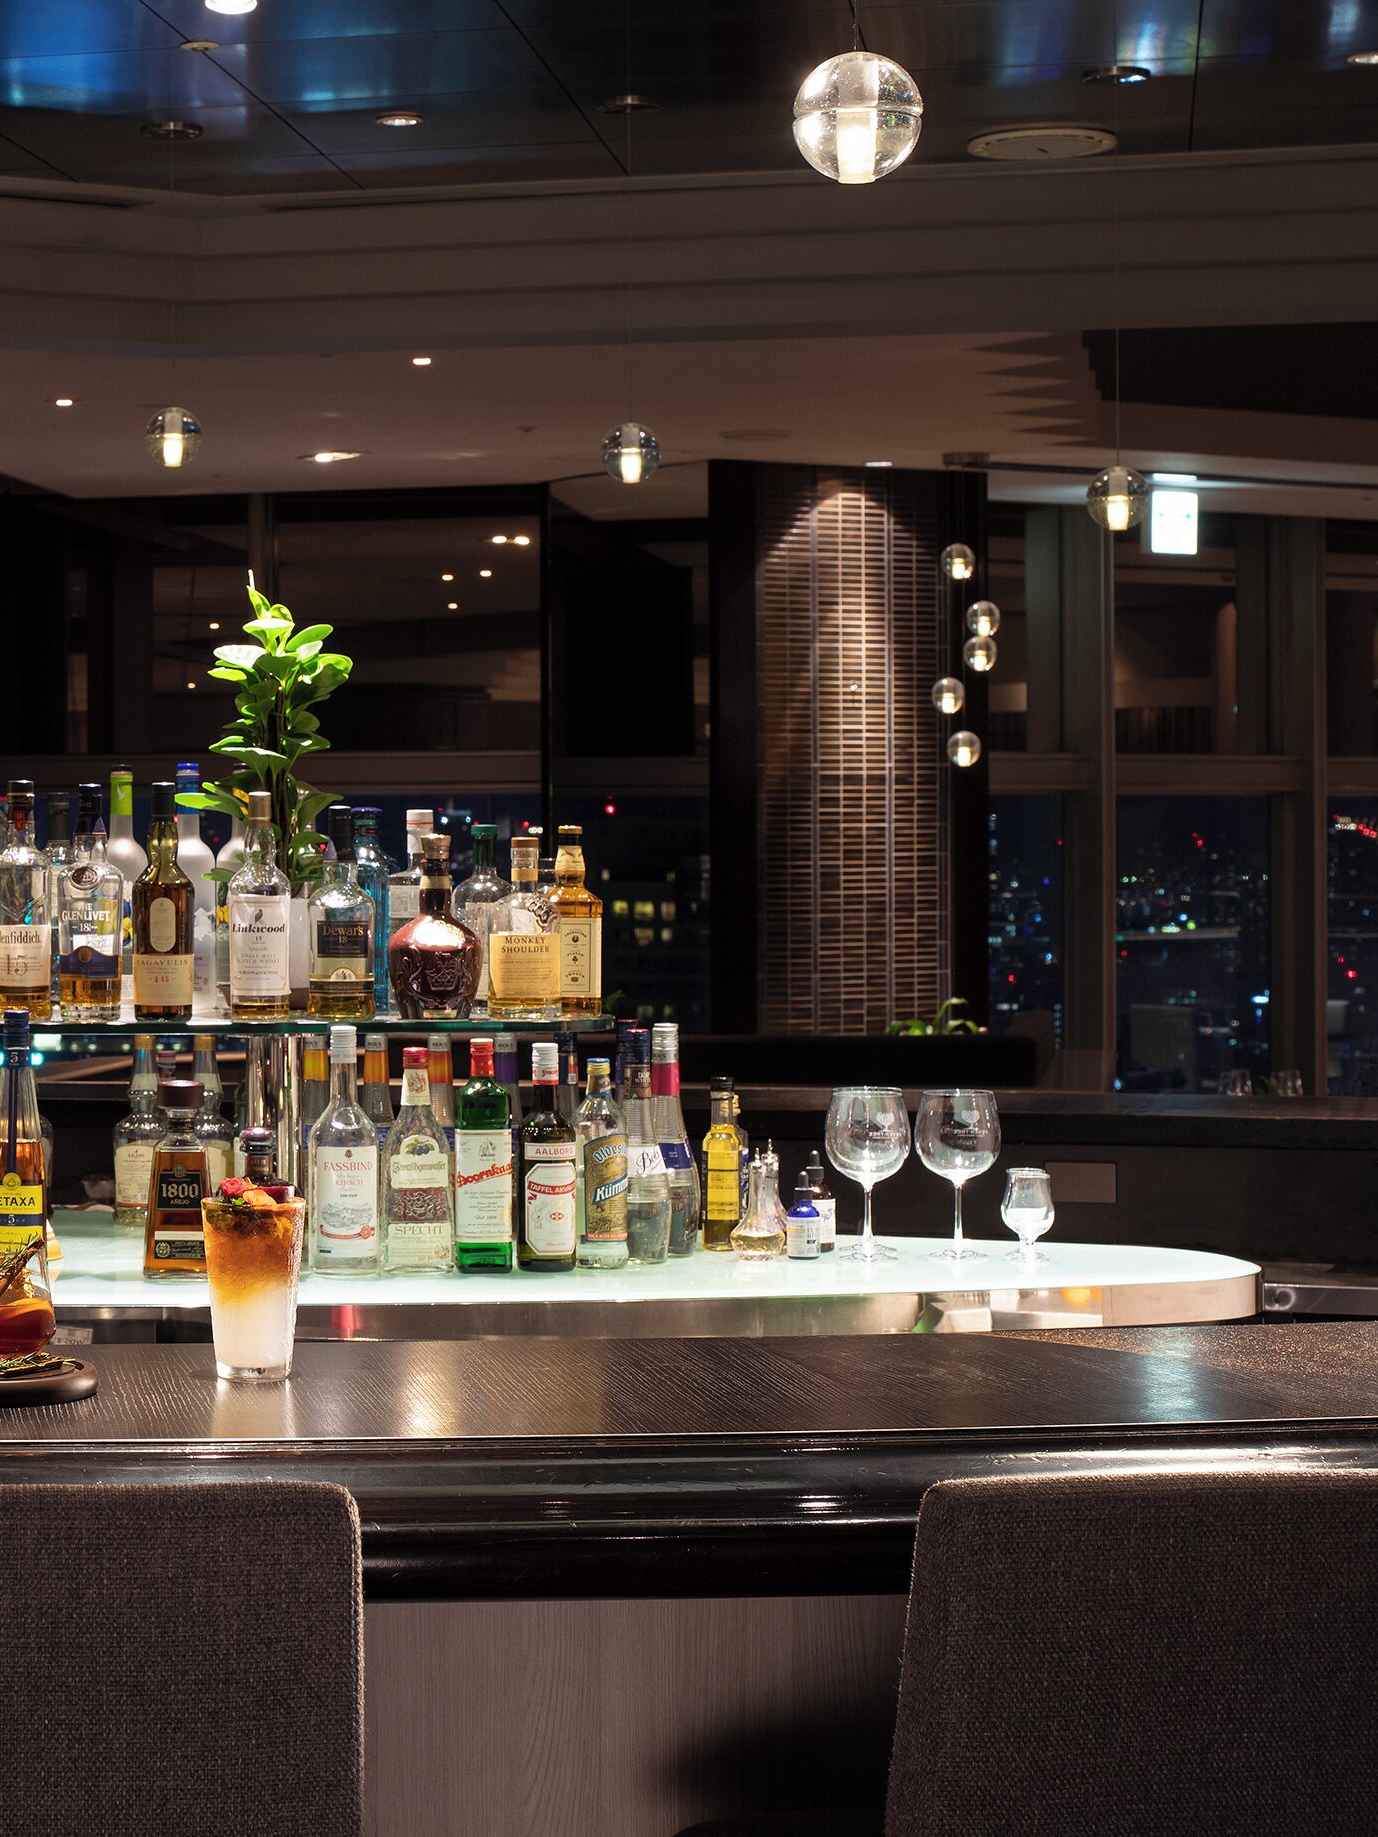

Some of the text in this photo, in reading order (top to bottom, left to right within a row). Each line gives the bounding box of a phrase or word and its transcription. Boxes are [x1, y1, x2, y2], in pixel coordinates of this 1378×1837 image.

[62, 911, 111, 921] GLENLIVET
[232, 923, 285, 933] Linkwood
[322, 925, 364, 936] Dewar's
[338, 935, 349, 943] 18
[505, 936, 547, 944] MONKEY
[501, 945, 550, 953] SHOULDER
[5, 954, 29, 976] 15
[324, 1161, 373, 1171] FASSBIND
[161, 1183, 200, 1198] 1800
[7, 1213, 15, 1224] 5
[394, 1225, 445, 1235] SPECHT
